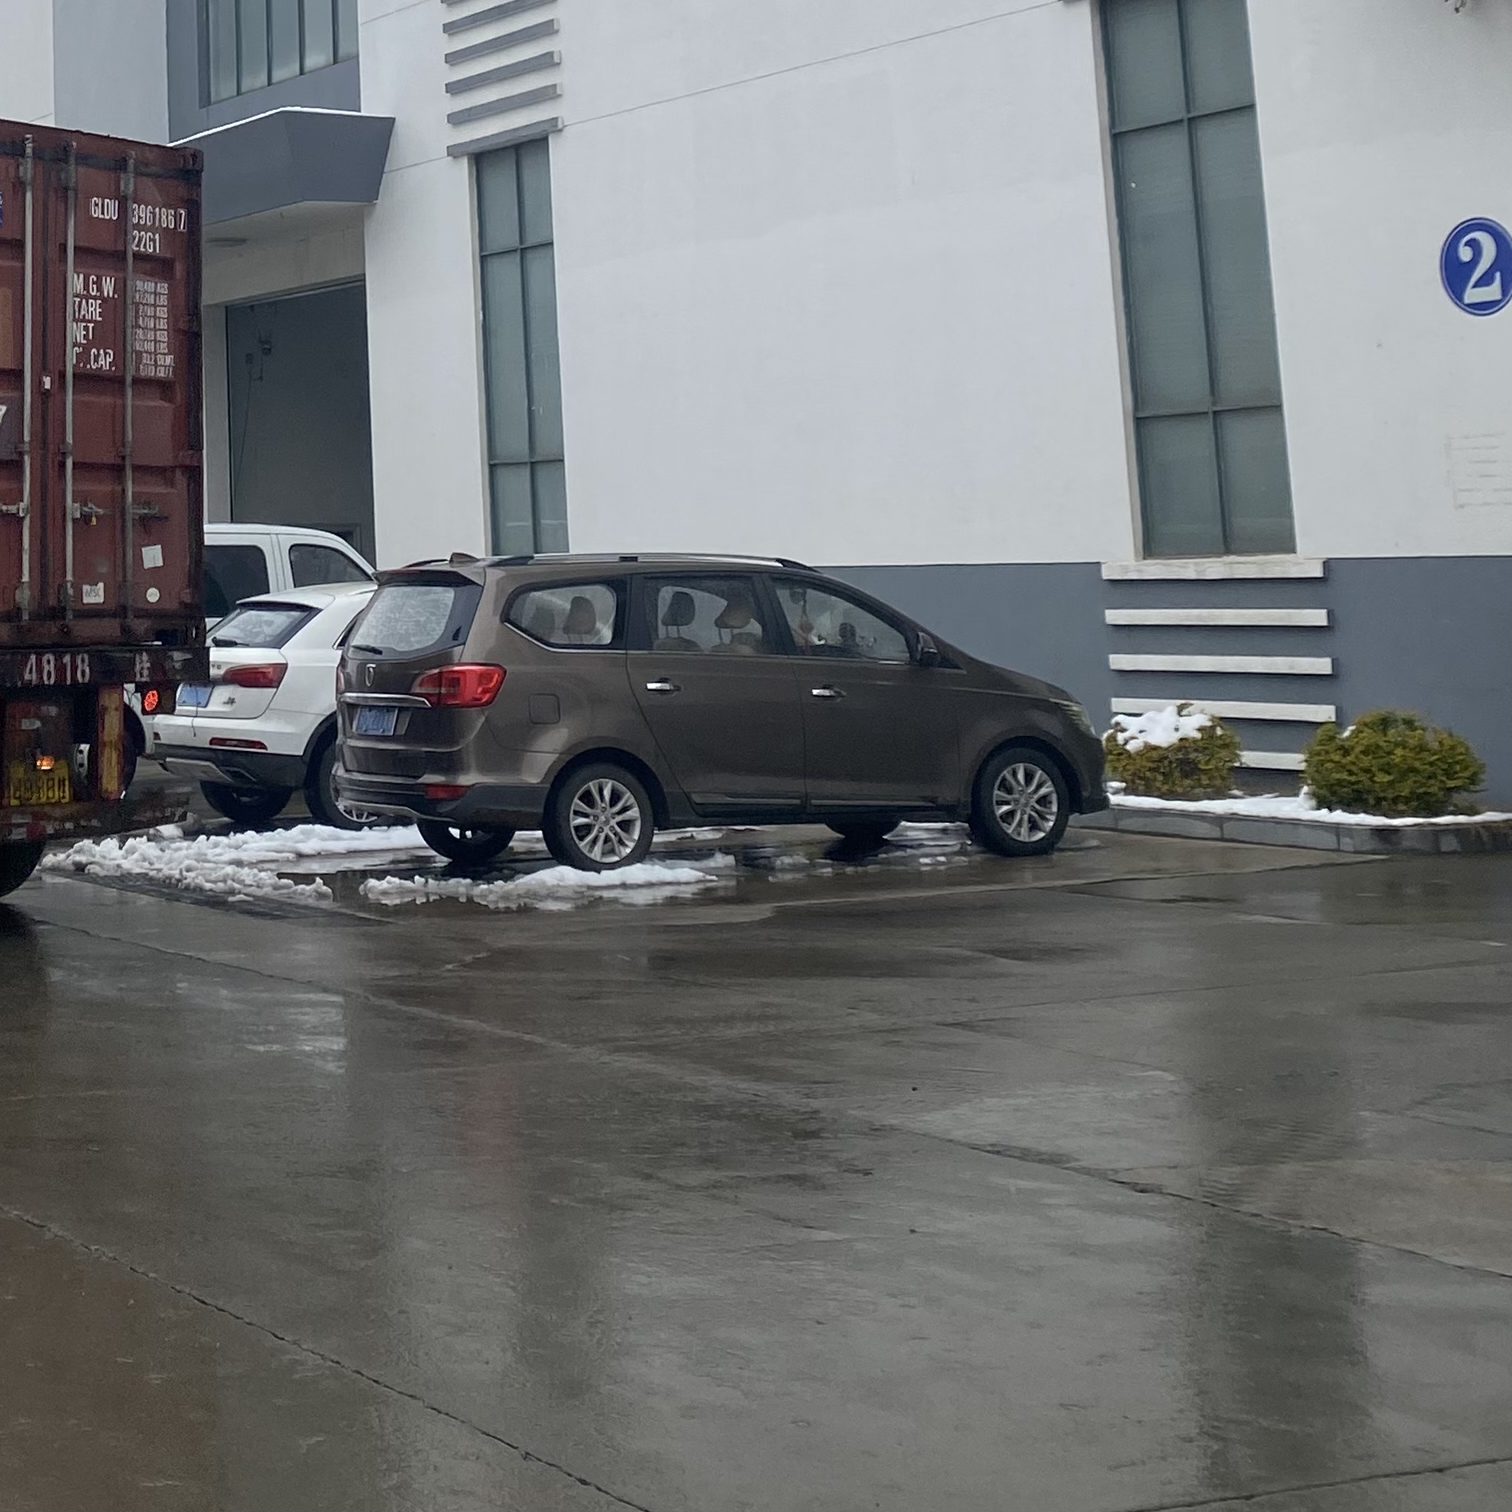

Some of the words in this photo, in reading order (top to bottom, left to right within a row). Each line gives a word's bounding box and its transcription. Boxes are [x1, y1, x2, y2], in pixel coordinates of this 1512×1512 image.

[91, 197, 119, 220] GLDU
[132, 203, 175, 229] 396186
[132, 230, 160, 254] 22G1
[1457, 230, 1503, 304] 2
[73, 297, 103, 321] TARE
[73, 321, 94, 344] NET
[22, 652, 91, 686] 4818
